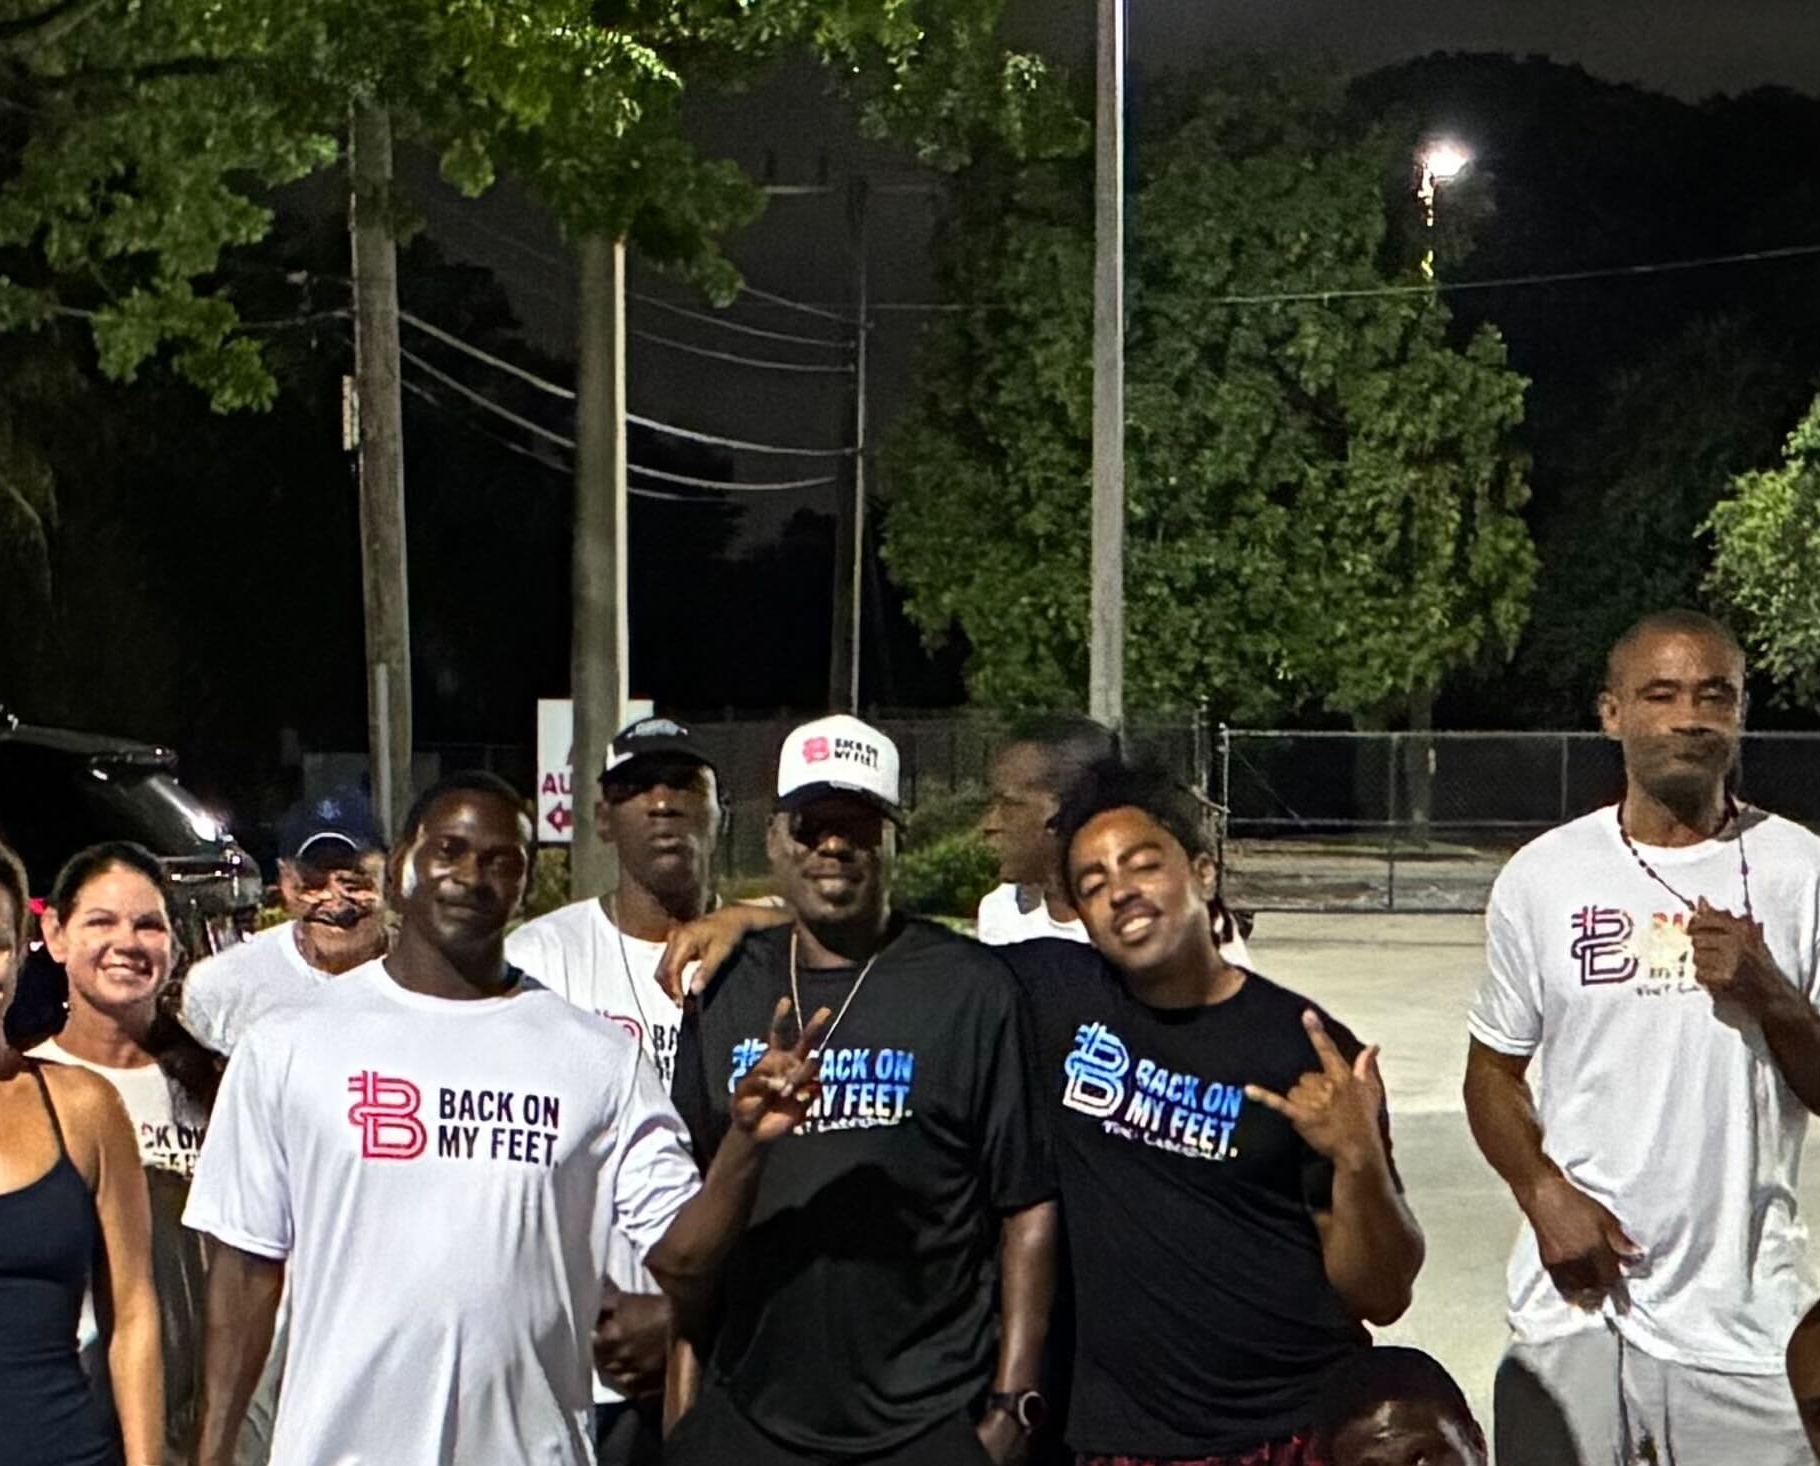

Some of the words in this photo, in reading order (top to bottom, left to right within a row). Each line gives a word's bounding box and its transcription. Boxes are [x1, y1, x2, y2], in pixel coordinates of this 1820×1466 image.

[875, 1049, 915, 1083] ON
[438, 1087, 515, 1124] BACK
[522, 1093, 561, 1130] ON
[842, 1082, 914, 1119] FEET.
[1135, 1058, 1201, 1110] BACK
[1202, 1082, 1244, 1119] ON
[437, 1124, 480, 1160] MY
[490, 1127, 560, 1170] FEET.
[1124, 1091, 1165, 1132] MY
[1168, 1107, 1239, 1159] FEET.
